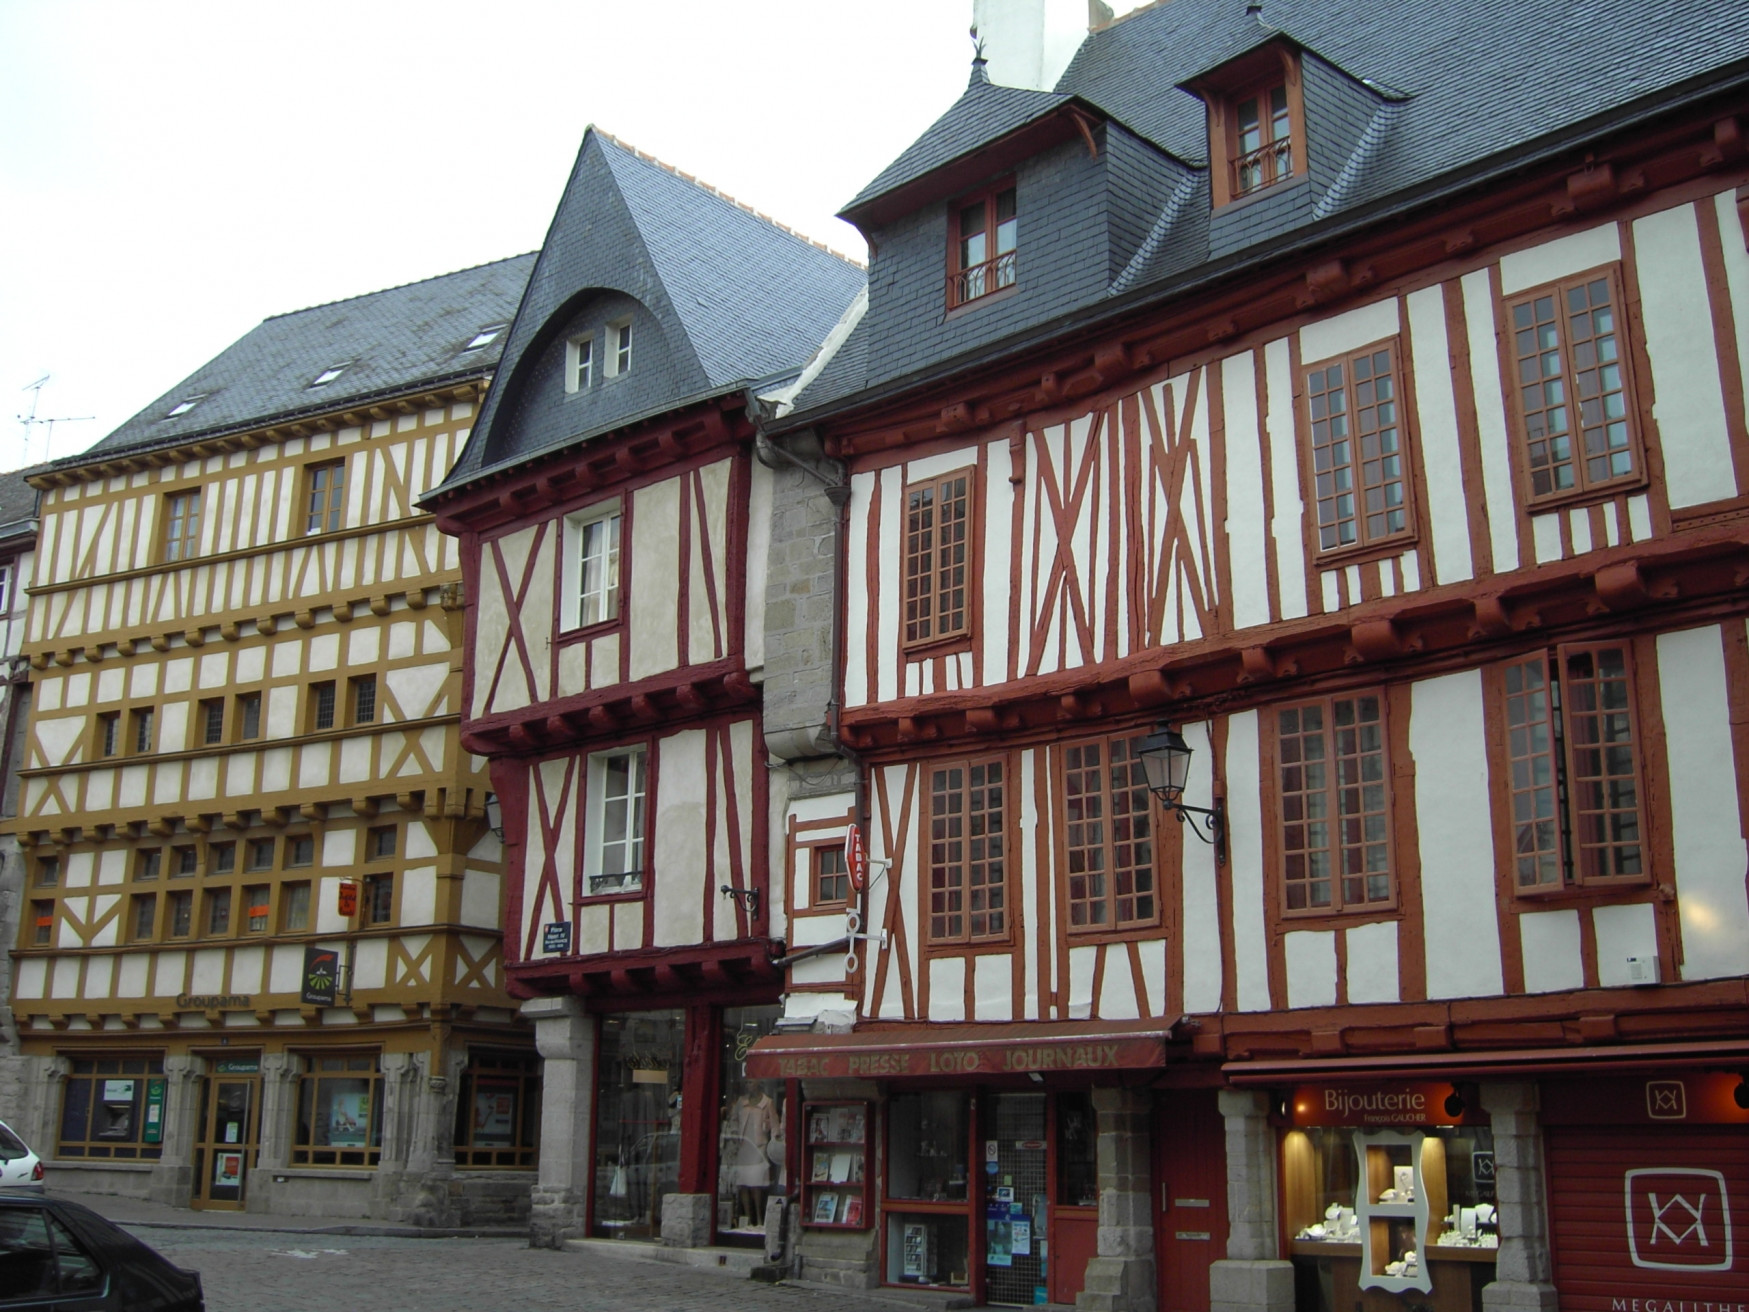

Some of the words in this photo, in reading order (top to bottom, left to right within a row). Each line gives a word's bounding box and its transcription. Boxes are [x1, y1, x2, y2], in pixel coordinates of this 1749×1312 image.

[855, 834, 863, 881] TABAC
[176, 992, 250, 1010] Groupama
[306, 992, 332, 1002] Groupama
[228, 1063, 258, 1072] Groupama
[778, 1057, 830, 1076] TABAC
[849, 1053, 910, 1073] PRESSE
[930, 1050, 980, 1072] LOTO
[1003, 1045, 1118, 1070] JOURNAUX
[1324, 1088, 1425, 1118] Bijouterie
[1364, 1114, 1390, 1123] François
[1391, 1113, 1426, 1122] GAUCHER
